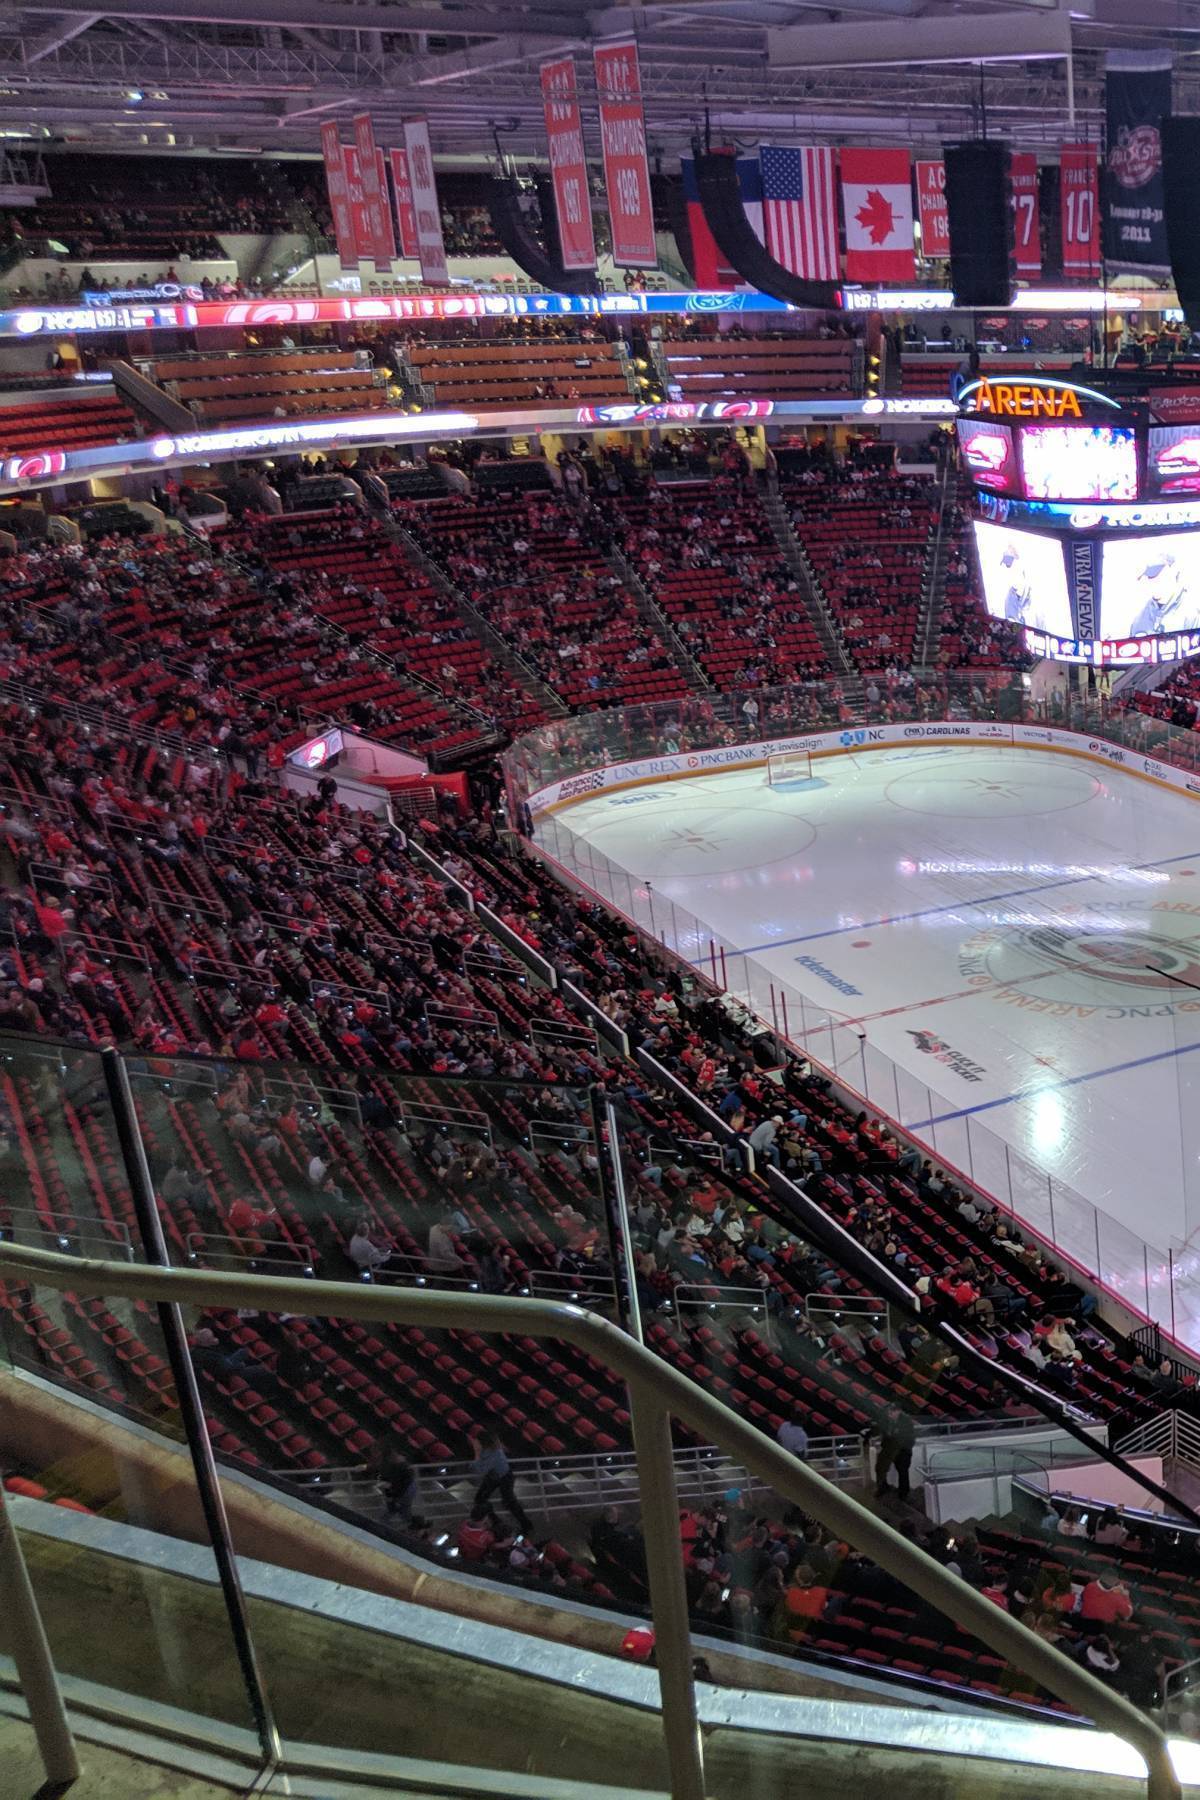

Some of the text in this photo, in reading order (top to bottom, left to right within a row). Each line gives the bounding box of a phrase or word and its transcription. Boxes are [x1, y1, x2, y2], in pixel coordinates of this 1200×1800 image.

[1066, 191, 1094, 242] 10
[1121, 226, 1152, 242] 2011
[975, 377, 1082, 418] ARENA
[1076, 586, 1095, 639] NEWS
[868, 730, 886, 741] NC
[926, 727, 970, 736] CAROLINAS
[778, 737, 824, 752] invisalign
[700, 748, 757, 766] PNC BANK
[614, 758, 682, 781] UNC REX
[560, 776, 593, 792] Advance
[794, 954, 864, 997] ticketmaster
[1105, 1004, 1176, 1019] PNC
